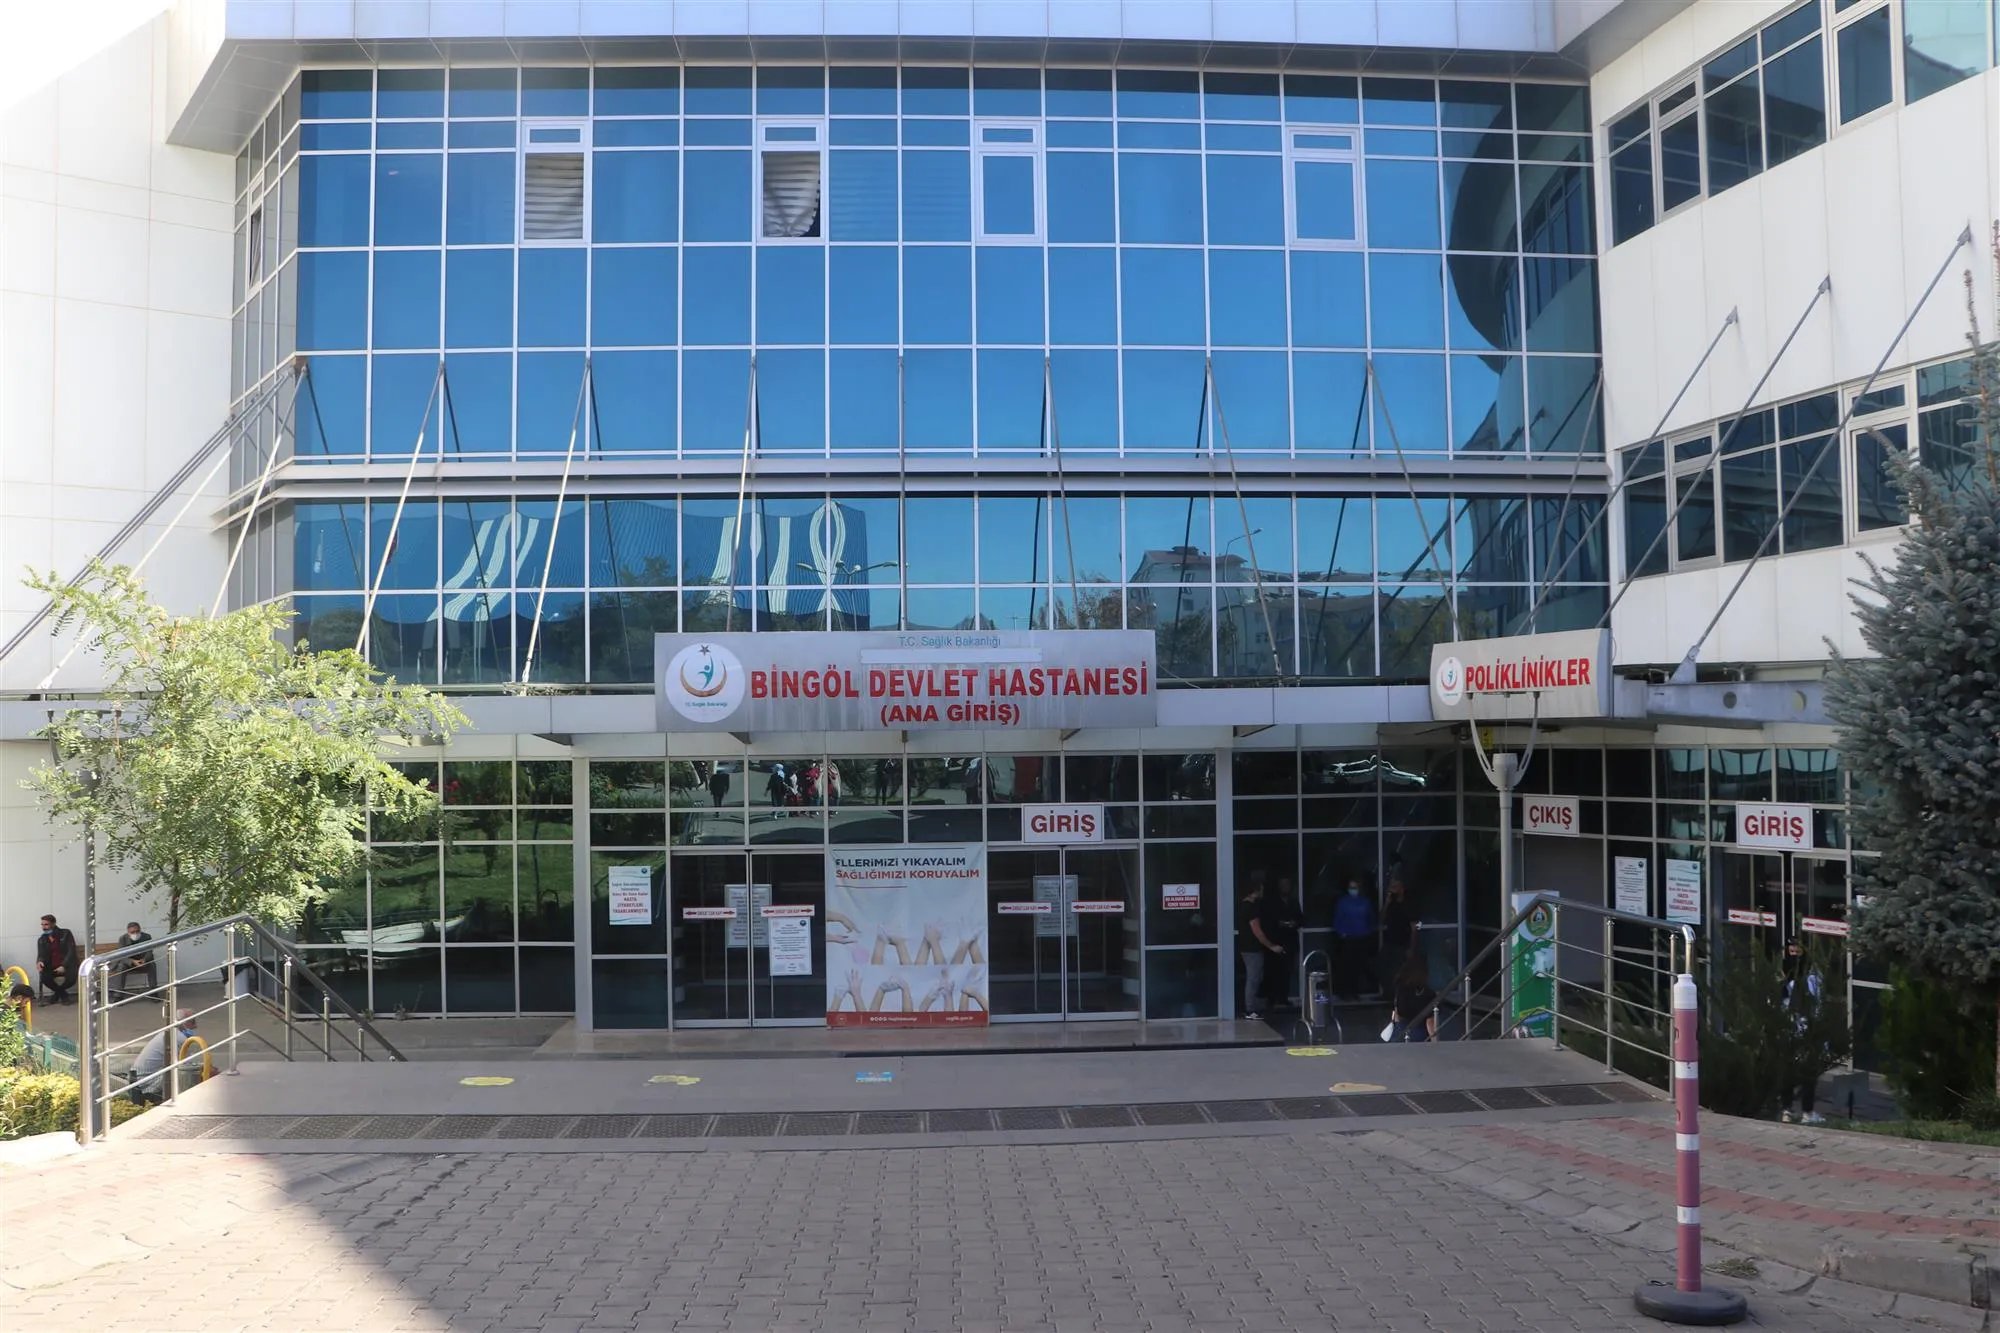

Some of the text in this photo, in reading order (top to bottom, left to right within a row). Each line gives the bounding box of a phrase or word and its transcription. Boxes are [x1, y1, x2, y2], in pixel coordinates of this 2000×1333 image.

[921, 635, 952, 649] Sağlık
[955, 635, 1001, 648] Bakanlığı
[751, 661, 1148, 699] BİNGÖL DEVLET HASTANESİ
[1465, 655, 1591, 691] POLİKLİNİKLER
[880, 700, 1020, 727] (ANA GİRİŞ)
[1031, 809, 1096, 838] GİRİŞ
[1529, 805, 1573, 830] ÇIKIŞ
[1744, 810, 1804, 844] GİRİŞ
[835, 867, 980, 880] SAĞLIĞIMIZI KORUYALIM
[902, 857, 966, 867] YIKAYALIM
